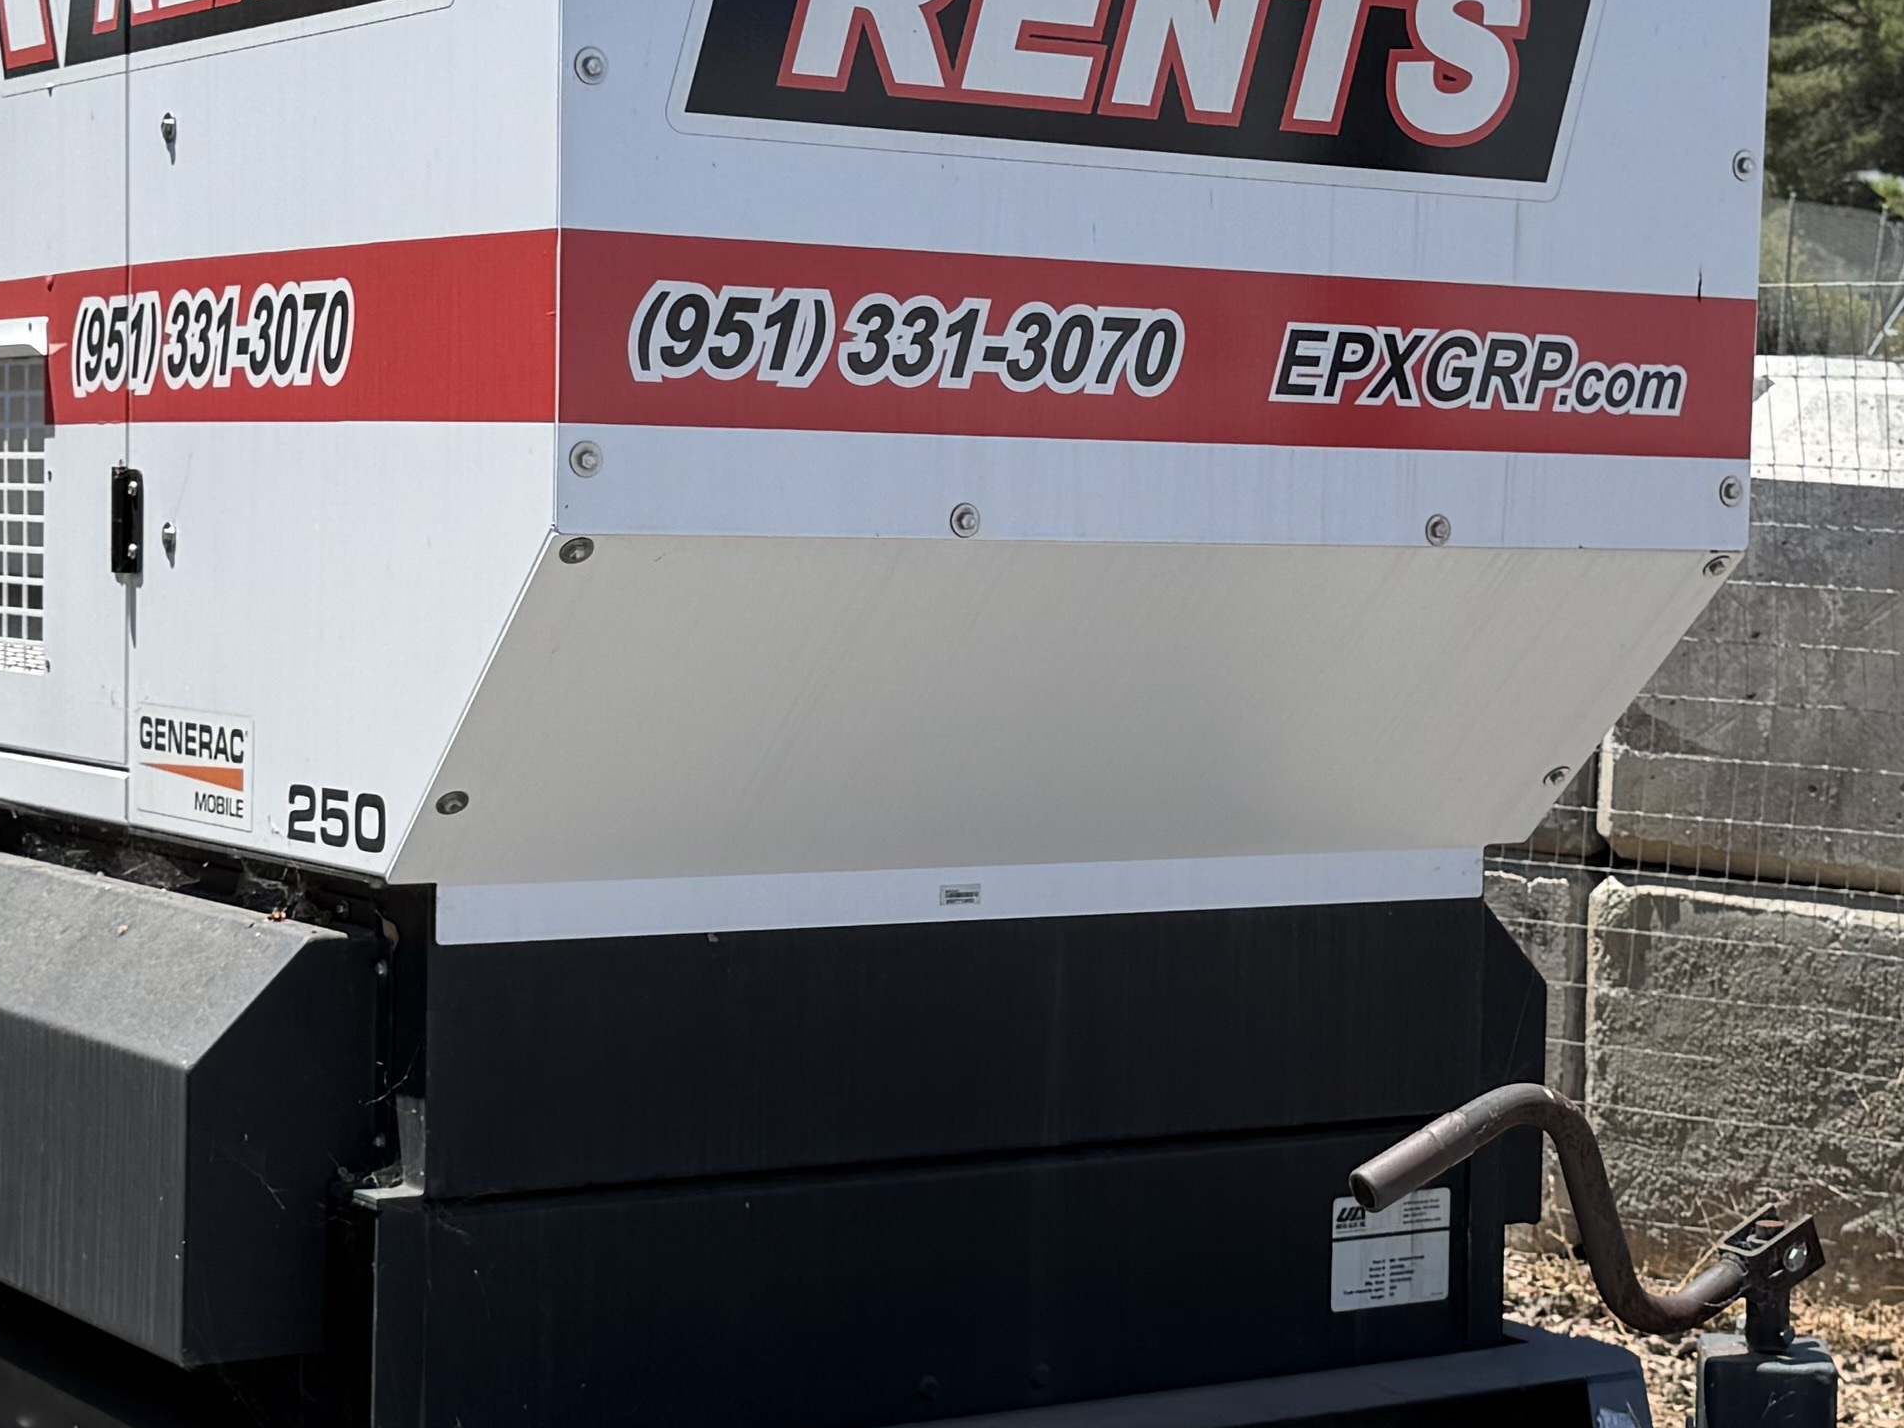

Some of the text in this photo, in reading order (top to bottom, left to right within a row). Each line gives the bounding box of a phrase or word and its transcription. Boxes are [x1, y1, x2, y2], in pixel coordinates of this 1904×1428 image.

[75, 289, 348, 388] (951) 331-3070
[636, 293, 1179, 389] (951) 331-3070
[1280, 328, 1685, 410] EPXGRP.com
[139, 715, 245, 763] GENERAC
[194, 790, 245, 819] MOBILE
[288, 785, 386, 853] 250
